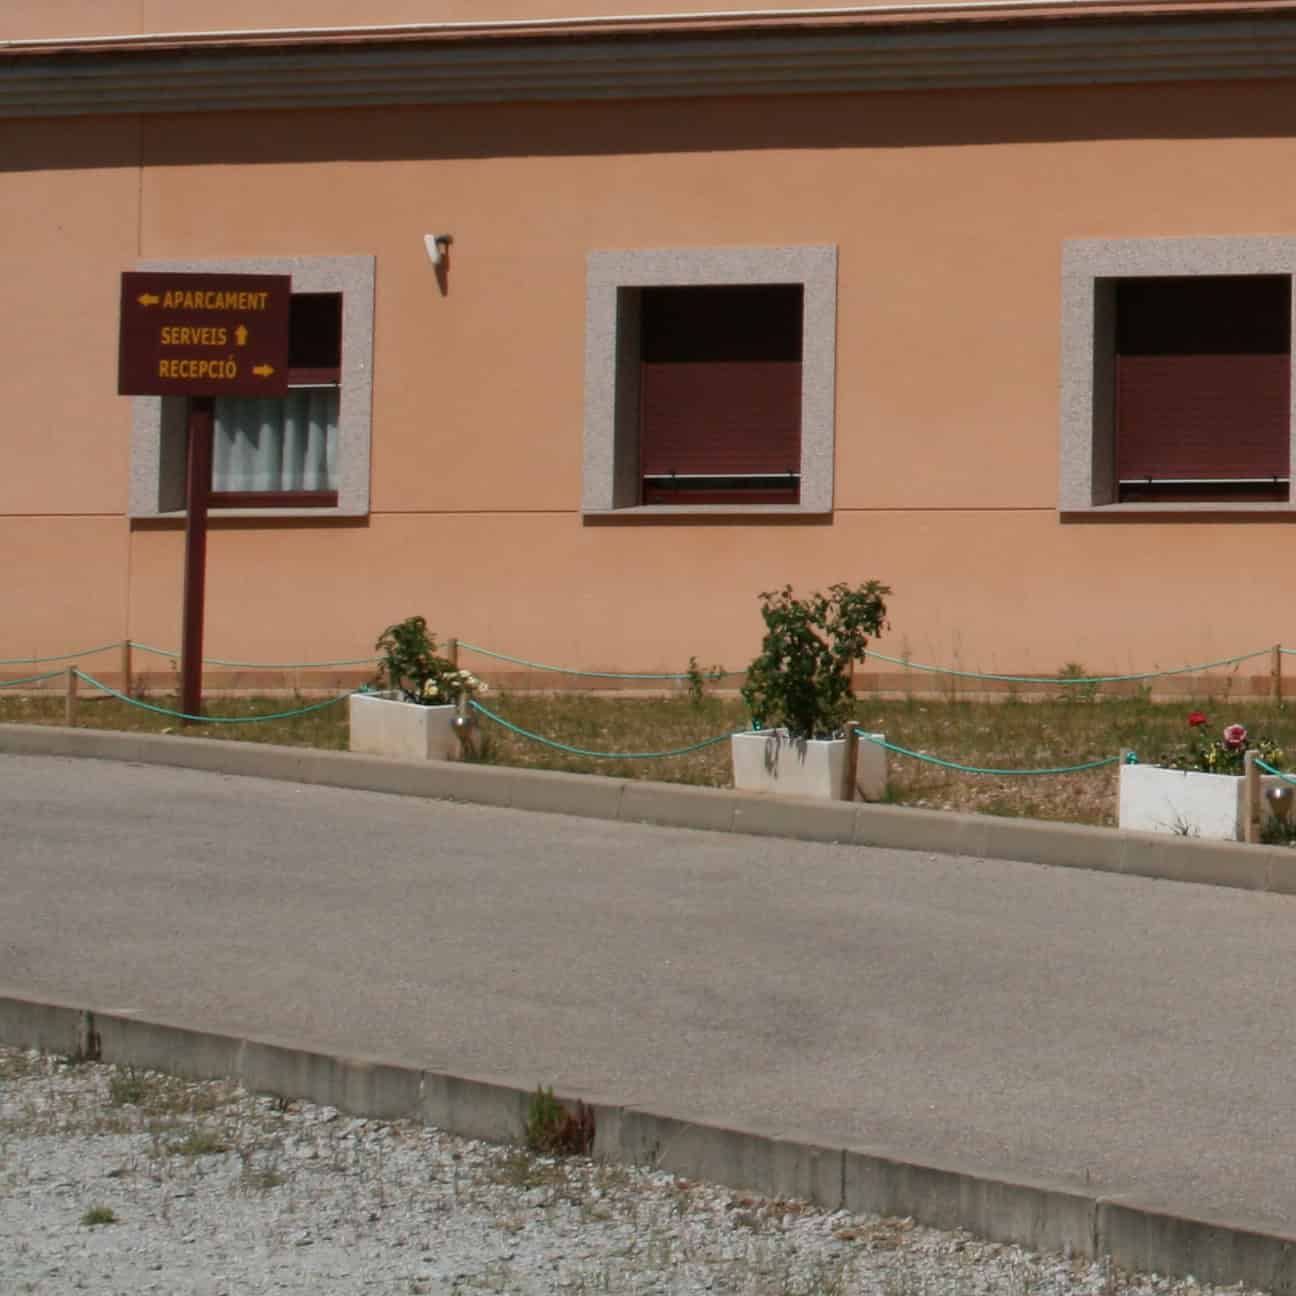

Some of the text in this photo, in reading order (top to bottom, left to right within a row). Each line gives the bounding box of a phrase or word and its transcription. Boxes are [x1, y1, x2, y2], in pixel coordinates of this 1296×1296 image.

[163, 291, 268, 310] APARCAMENT
[161, 327, 227, 345] SERVEIS
[159, 354, 237, 379] RECEPCIÓ
